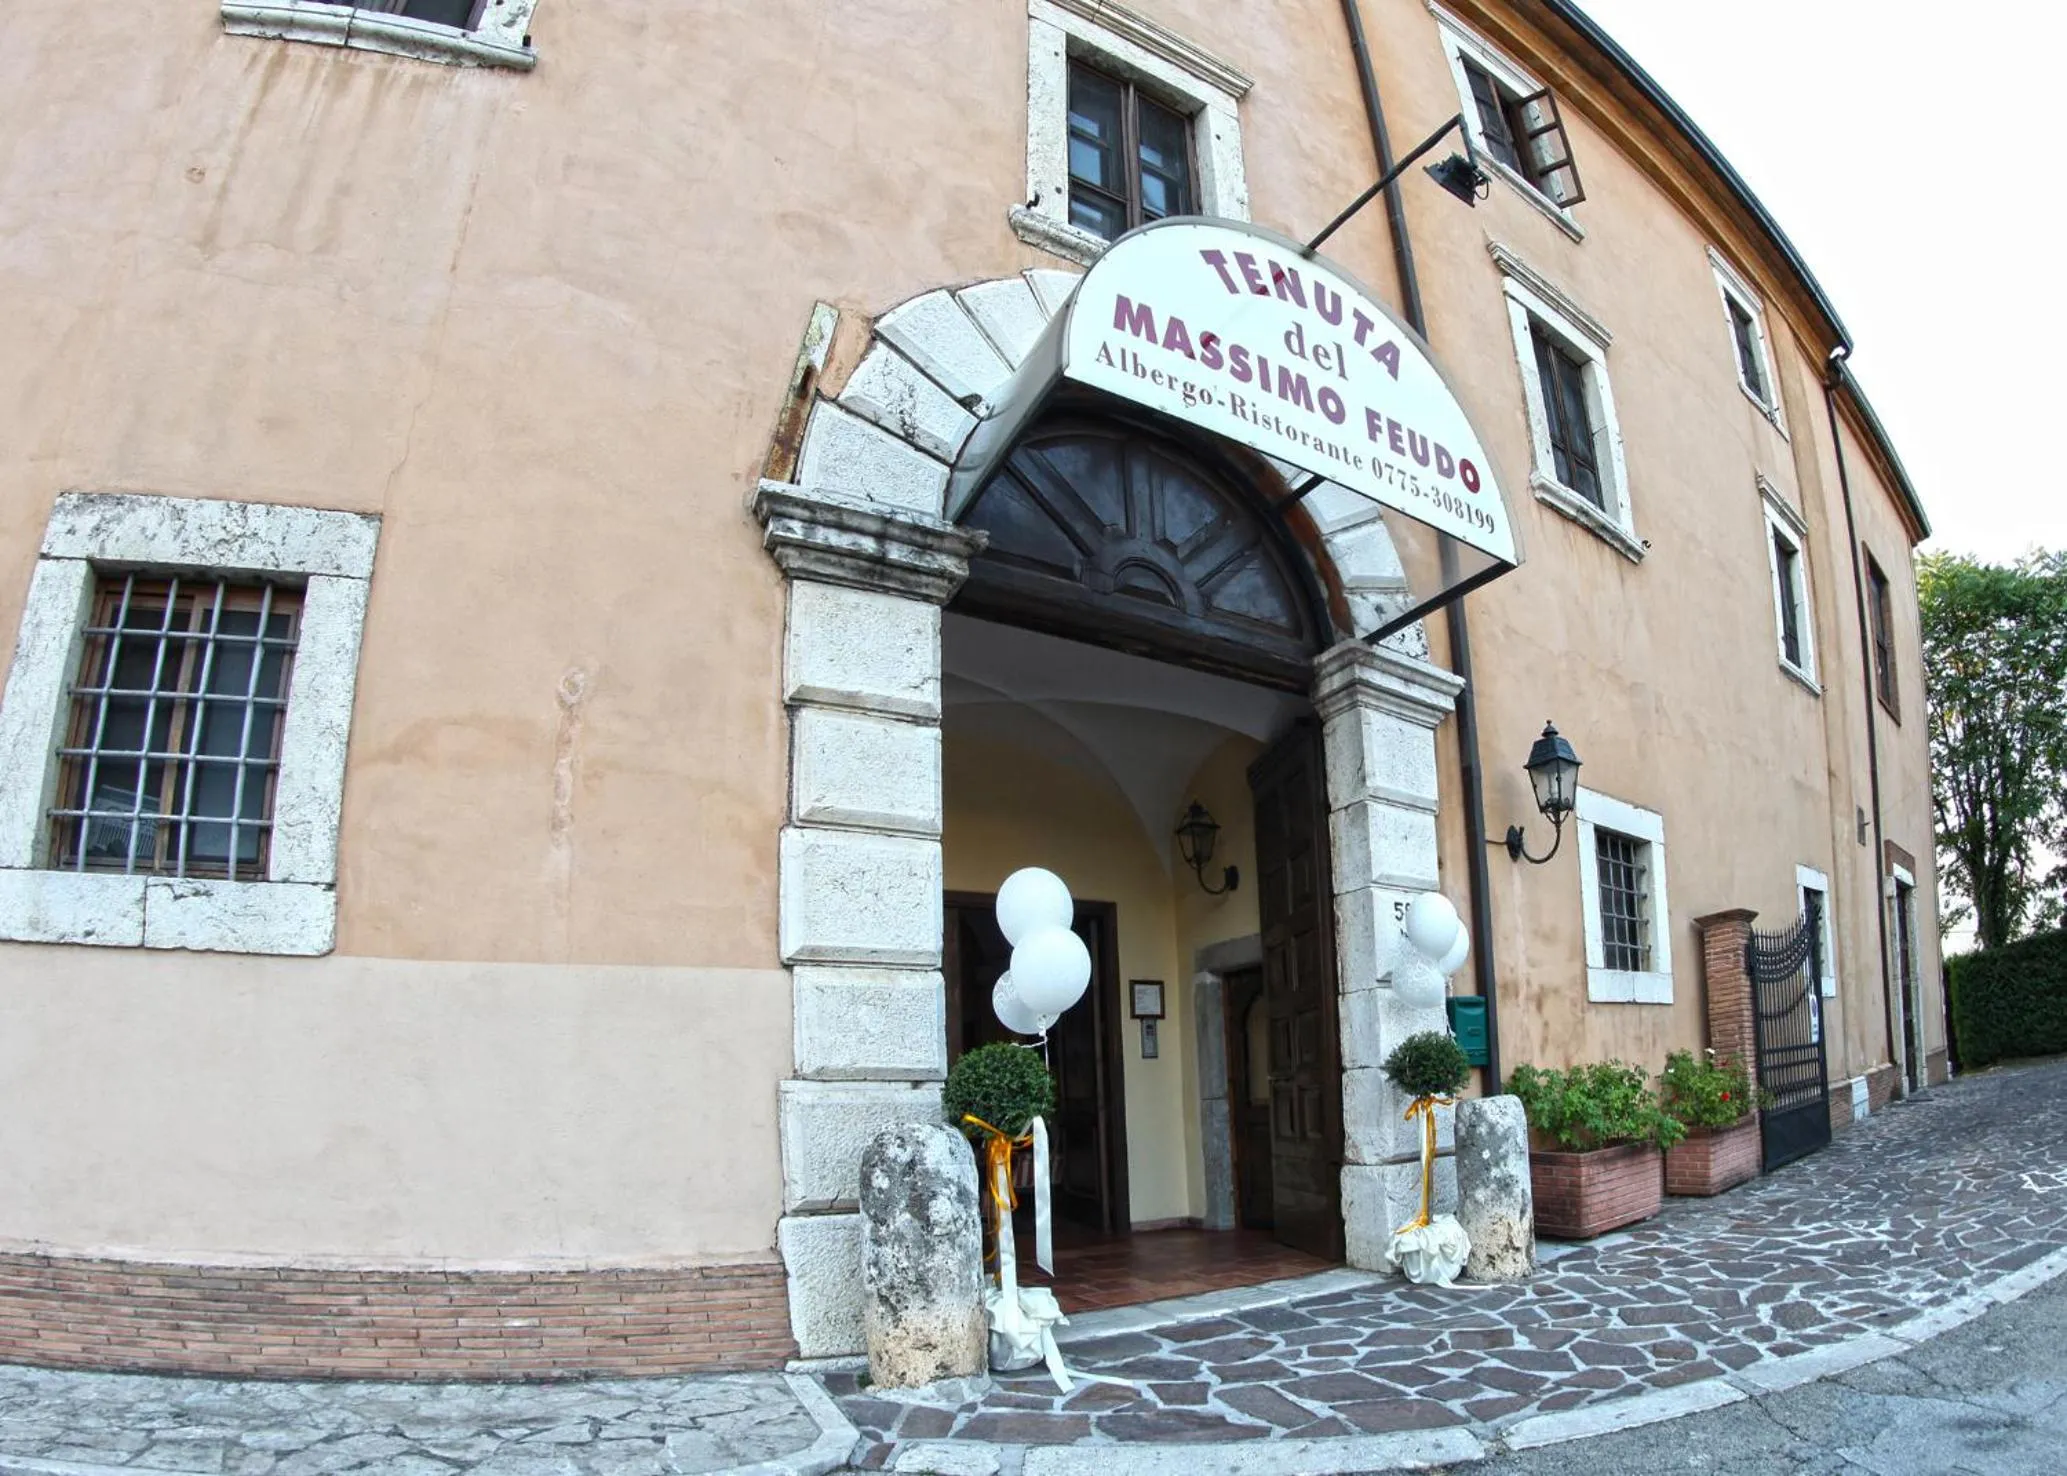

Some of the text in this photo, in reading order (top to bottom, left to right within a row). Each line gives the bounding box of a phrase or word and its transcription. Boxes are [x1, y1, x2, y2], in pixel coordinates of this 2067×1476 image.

[1113, 293, 1481, 494] MASSIMO FEUDO
[1199, 249, 1401, 382] TENUTA
[1284, 320, 1348, 381] del
[1095, 340, 1495, 534] Albergo-Ristorante 0775-308199
